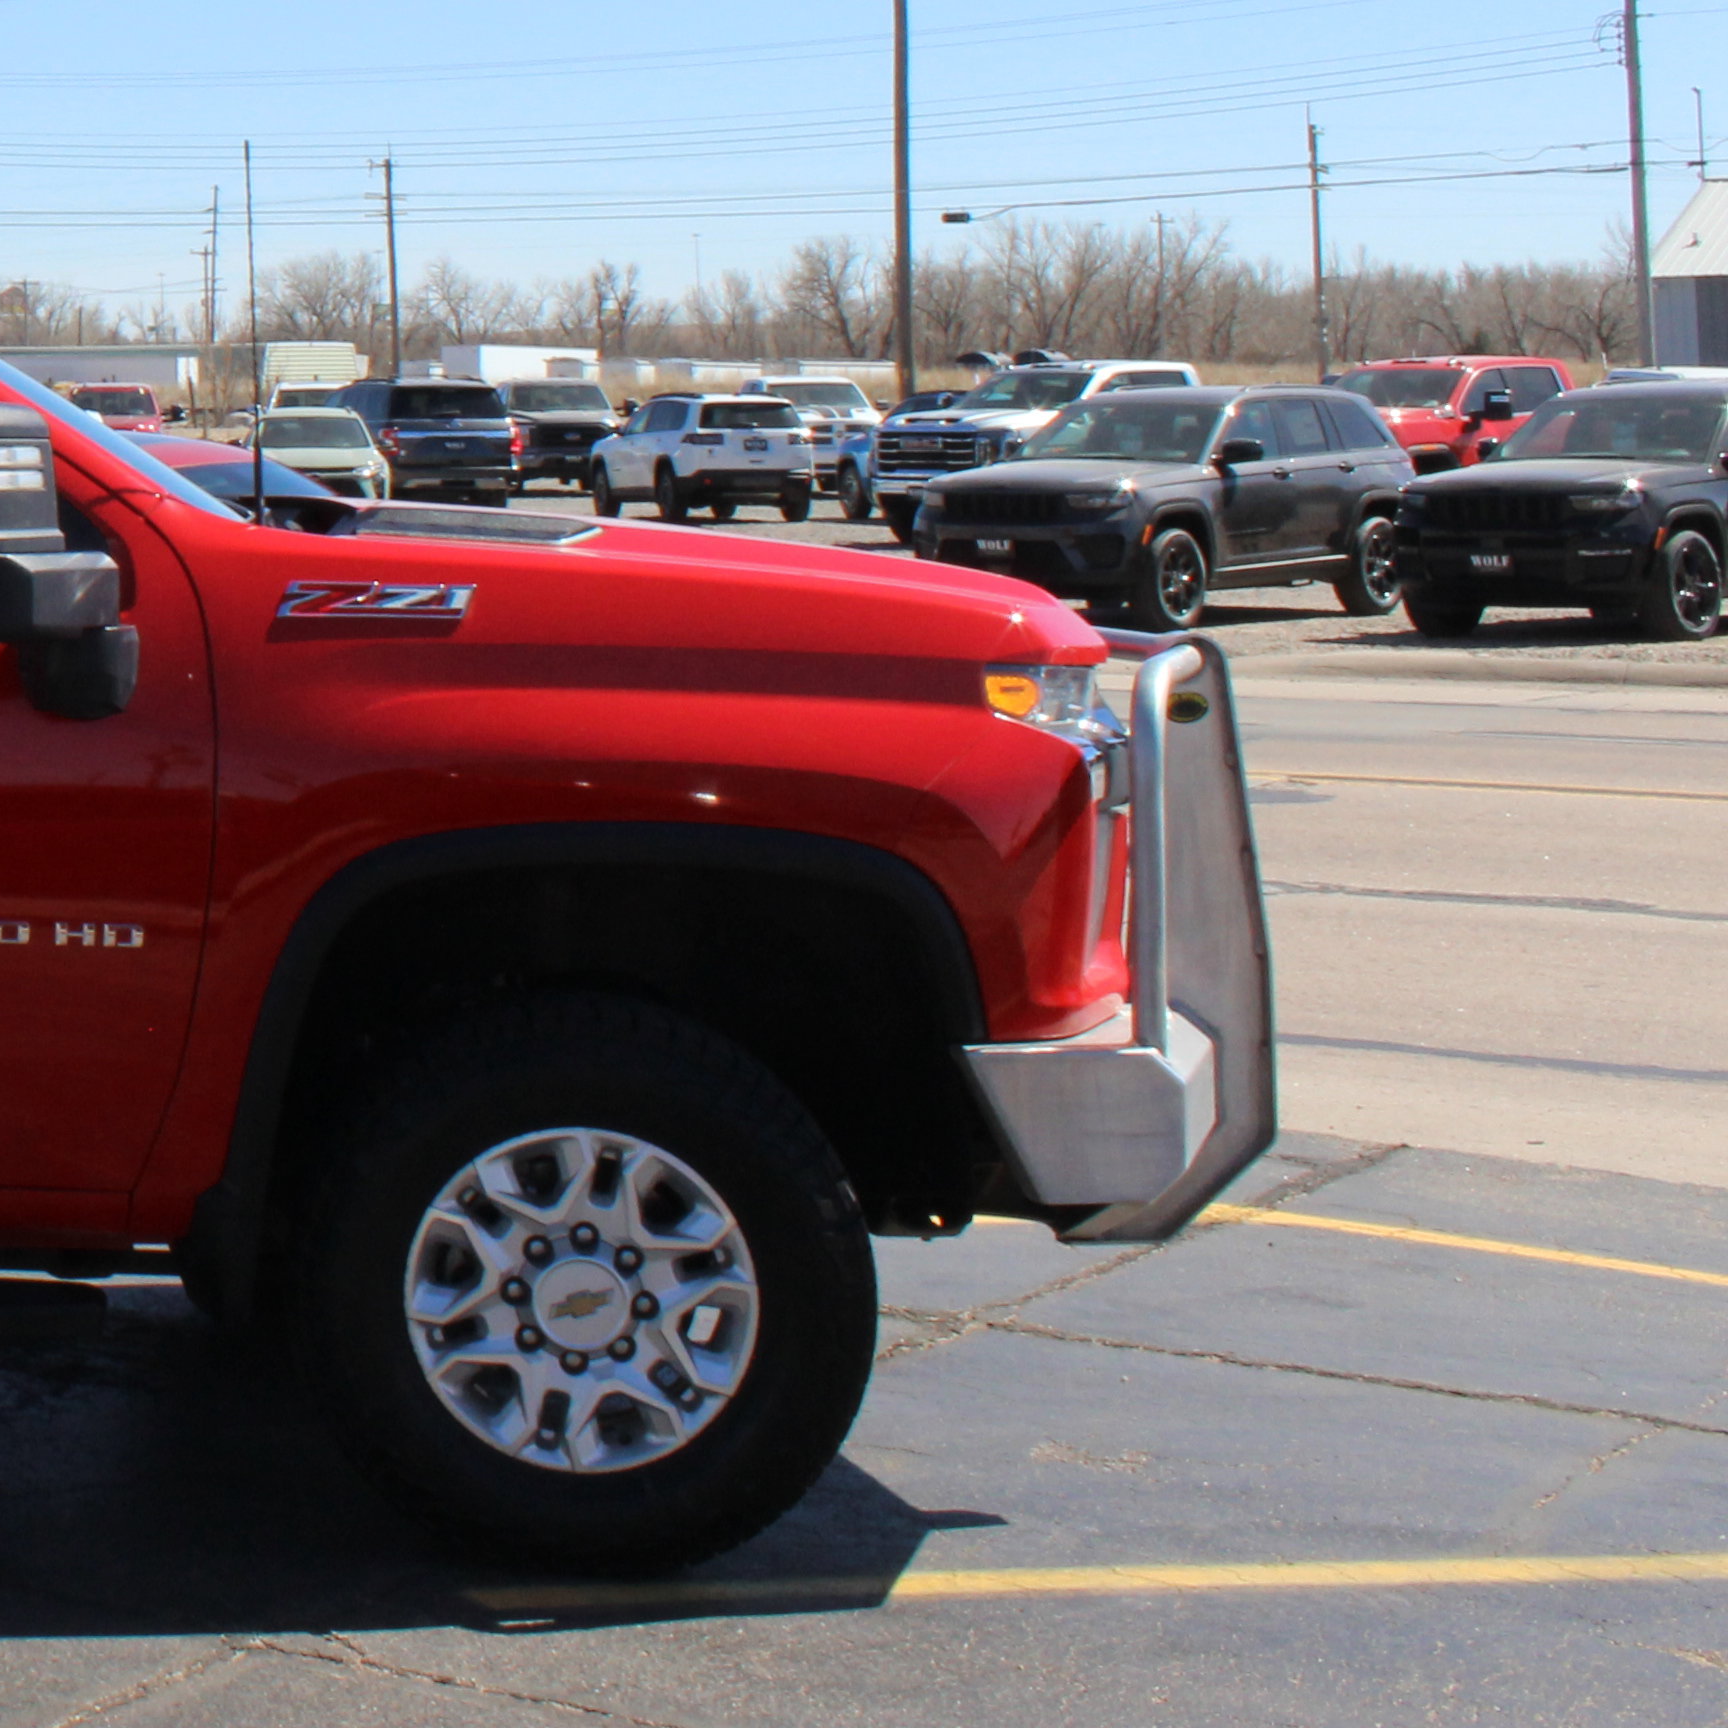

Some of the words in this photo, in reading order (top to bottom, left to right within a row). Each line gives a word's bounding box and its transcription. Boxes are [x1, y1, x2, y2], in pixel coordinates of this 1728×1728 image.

[1470, 554, 1512, 567] WOLF
[276, 580, 478, 619] Z71
[55, 922, 145, 948] HD
